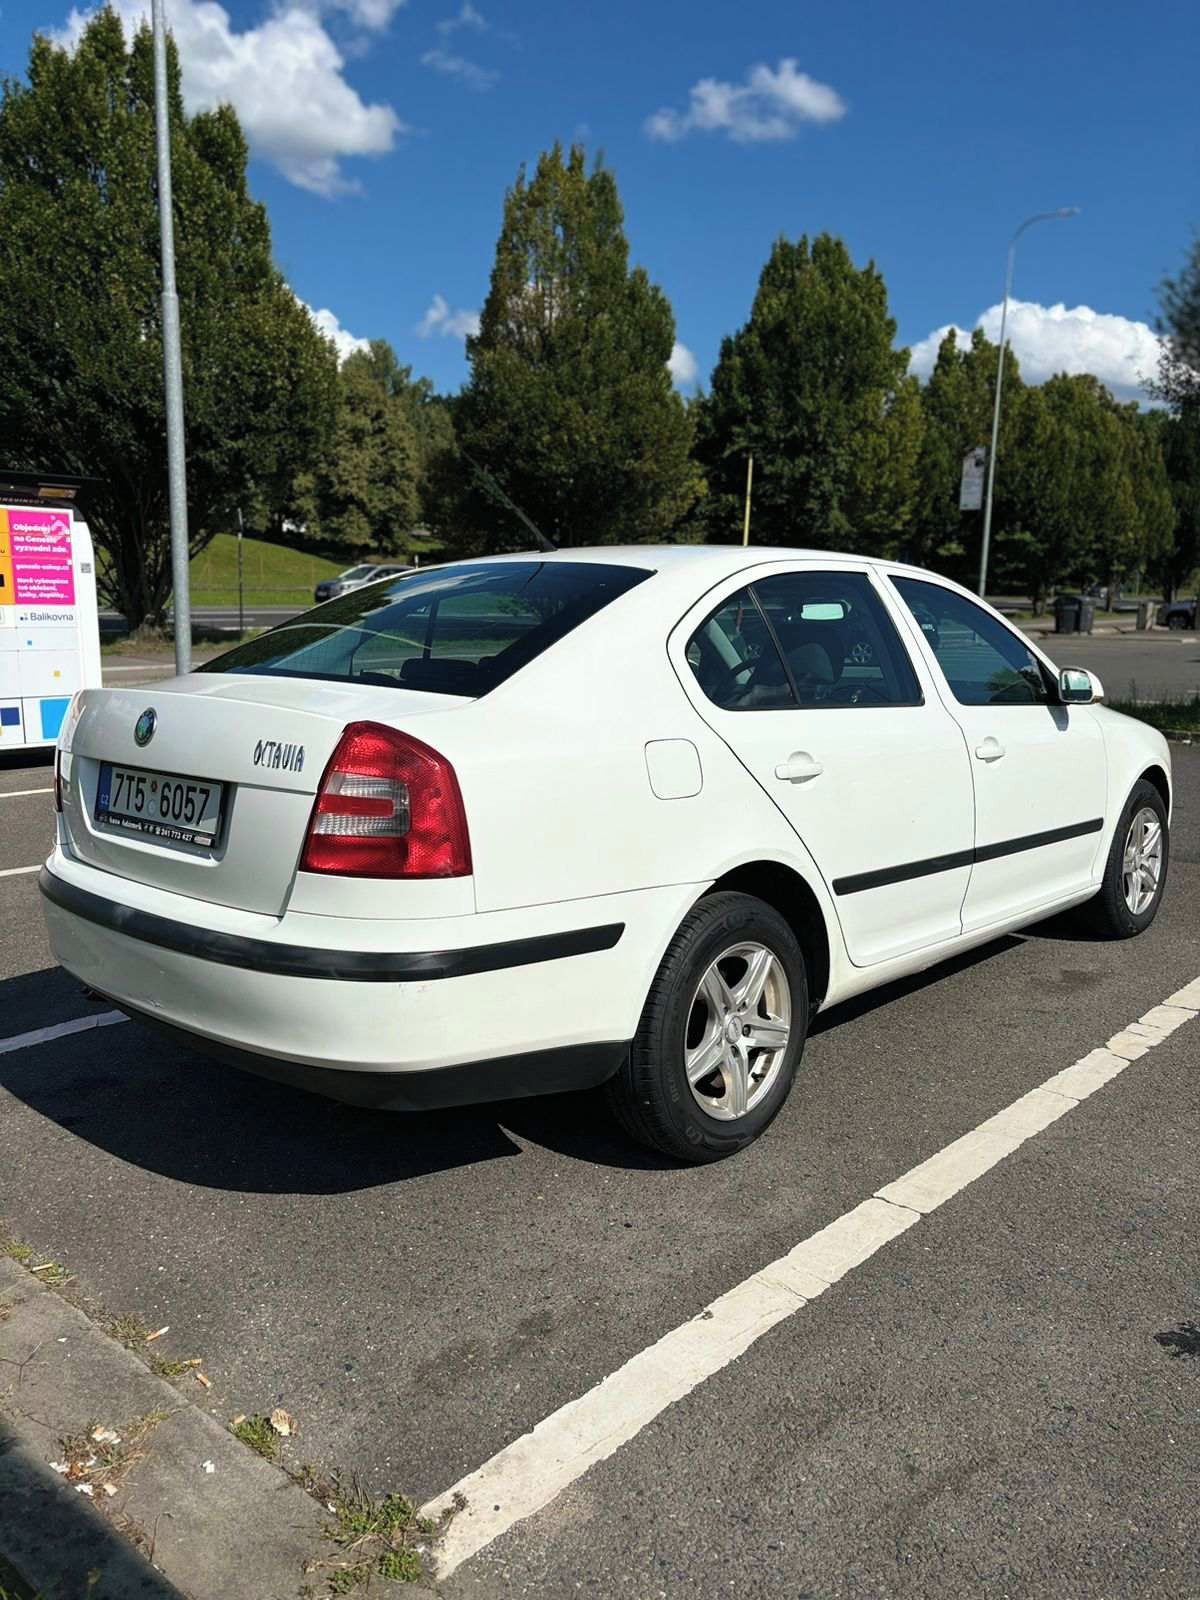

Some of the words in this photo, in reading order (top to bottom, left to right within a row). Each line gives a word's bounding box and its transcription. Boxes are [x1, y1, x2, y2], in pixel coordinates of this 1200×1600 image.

[253, 739, 306, 772] OCTAVIA
[113, 773, 147, 812] 7T5
[160, 782, 210, 826] 6057
